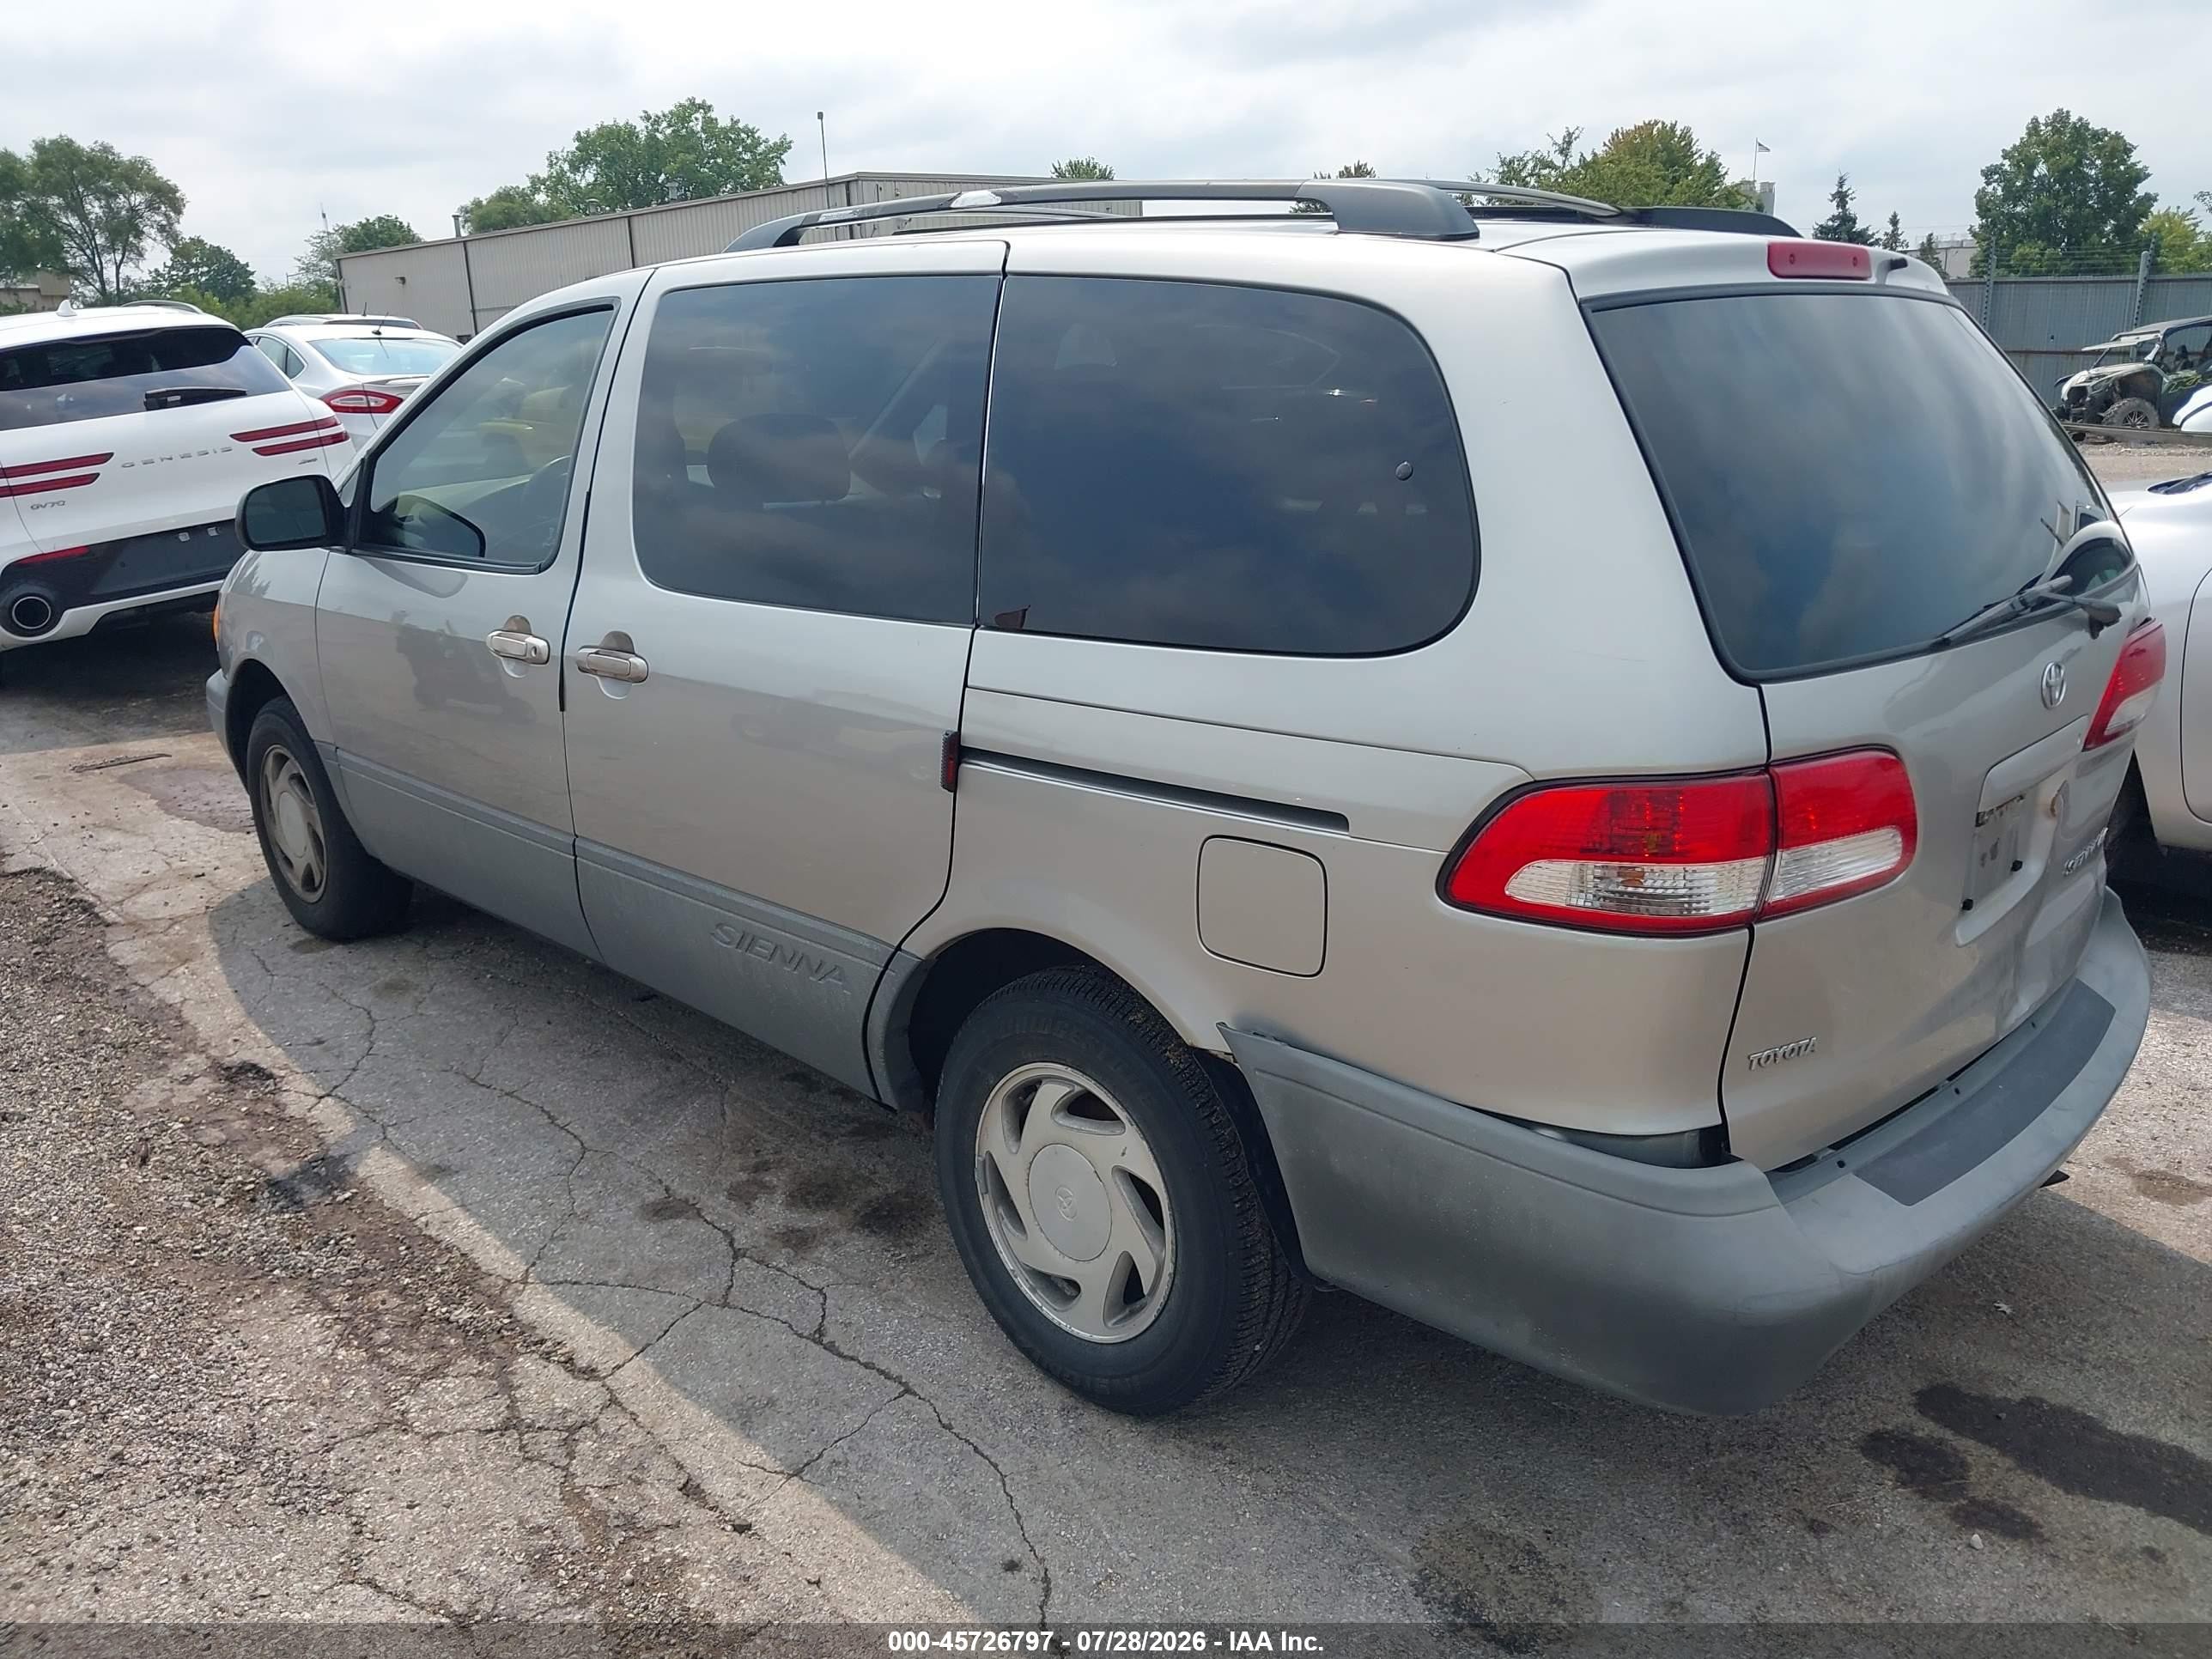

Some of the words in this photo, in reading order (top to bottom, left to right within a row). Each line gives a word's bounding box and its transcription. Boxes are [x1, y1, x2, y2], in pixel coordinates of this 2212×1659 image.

[121, 447, 233, 468] GENESIS
[30, 500, 66, 511] GV70
[710, 922, 852, 995] SIENNA
[1748, 1036, 1817, 1071] TOYOTA
